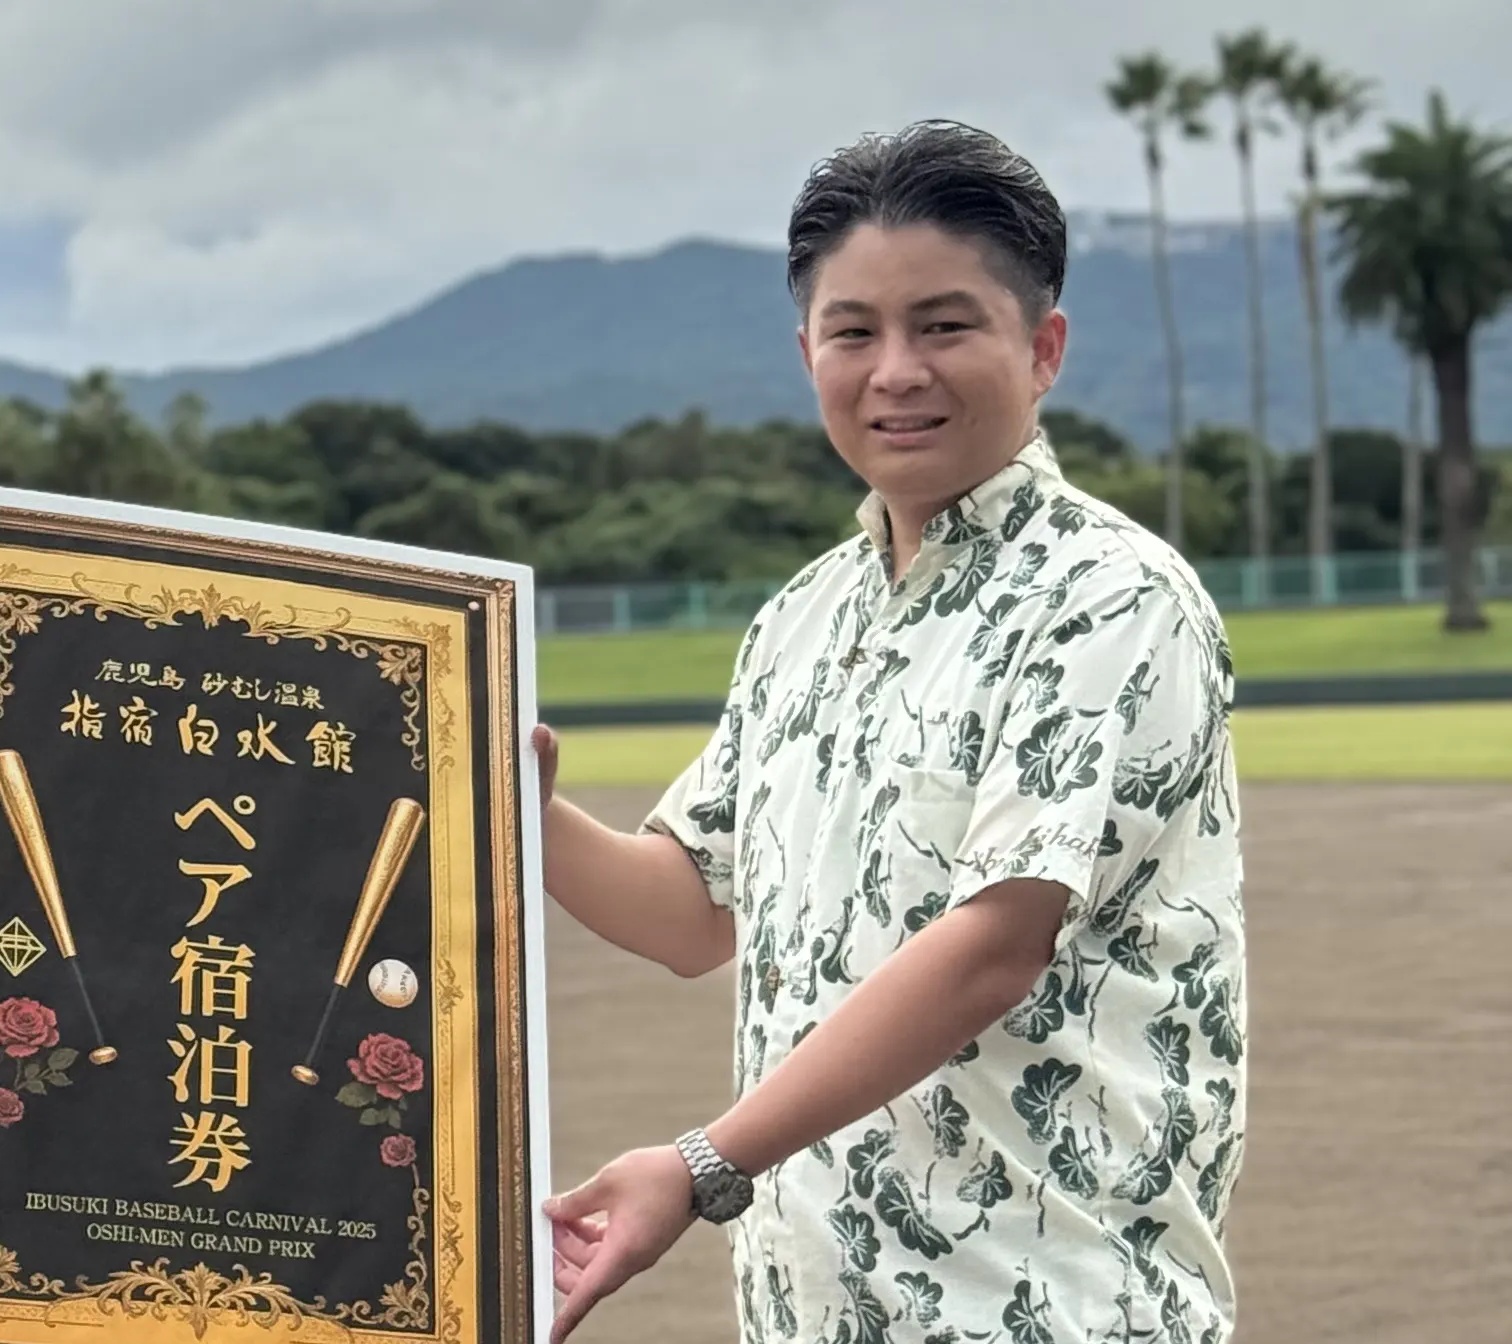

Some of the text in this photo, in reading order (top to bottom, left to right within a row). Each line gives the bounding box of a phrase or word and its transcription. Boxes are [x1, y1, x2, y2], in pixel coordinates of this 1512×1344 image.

[95, 659, 325, 710] 鹿児島 砂むし温泉
[60, 689, 357, 774] 指宿白水館
[167, 794, 257, 1193] ペア宿泊券
[25, 1193, 377, 1239] IBUSUKI BASEBALL CARNIVAL 2025
[190, 1232, 263, 1254] GRAND
[269, 1240, 316, 1259] PRIX
